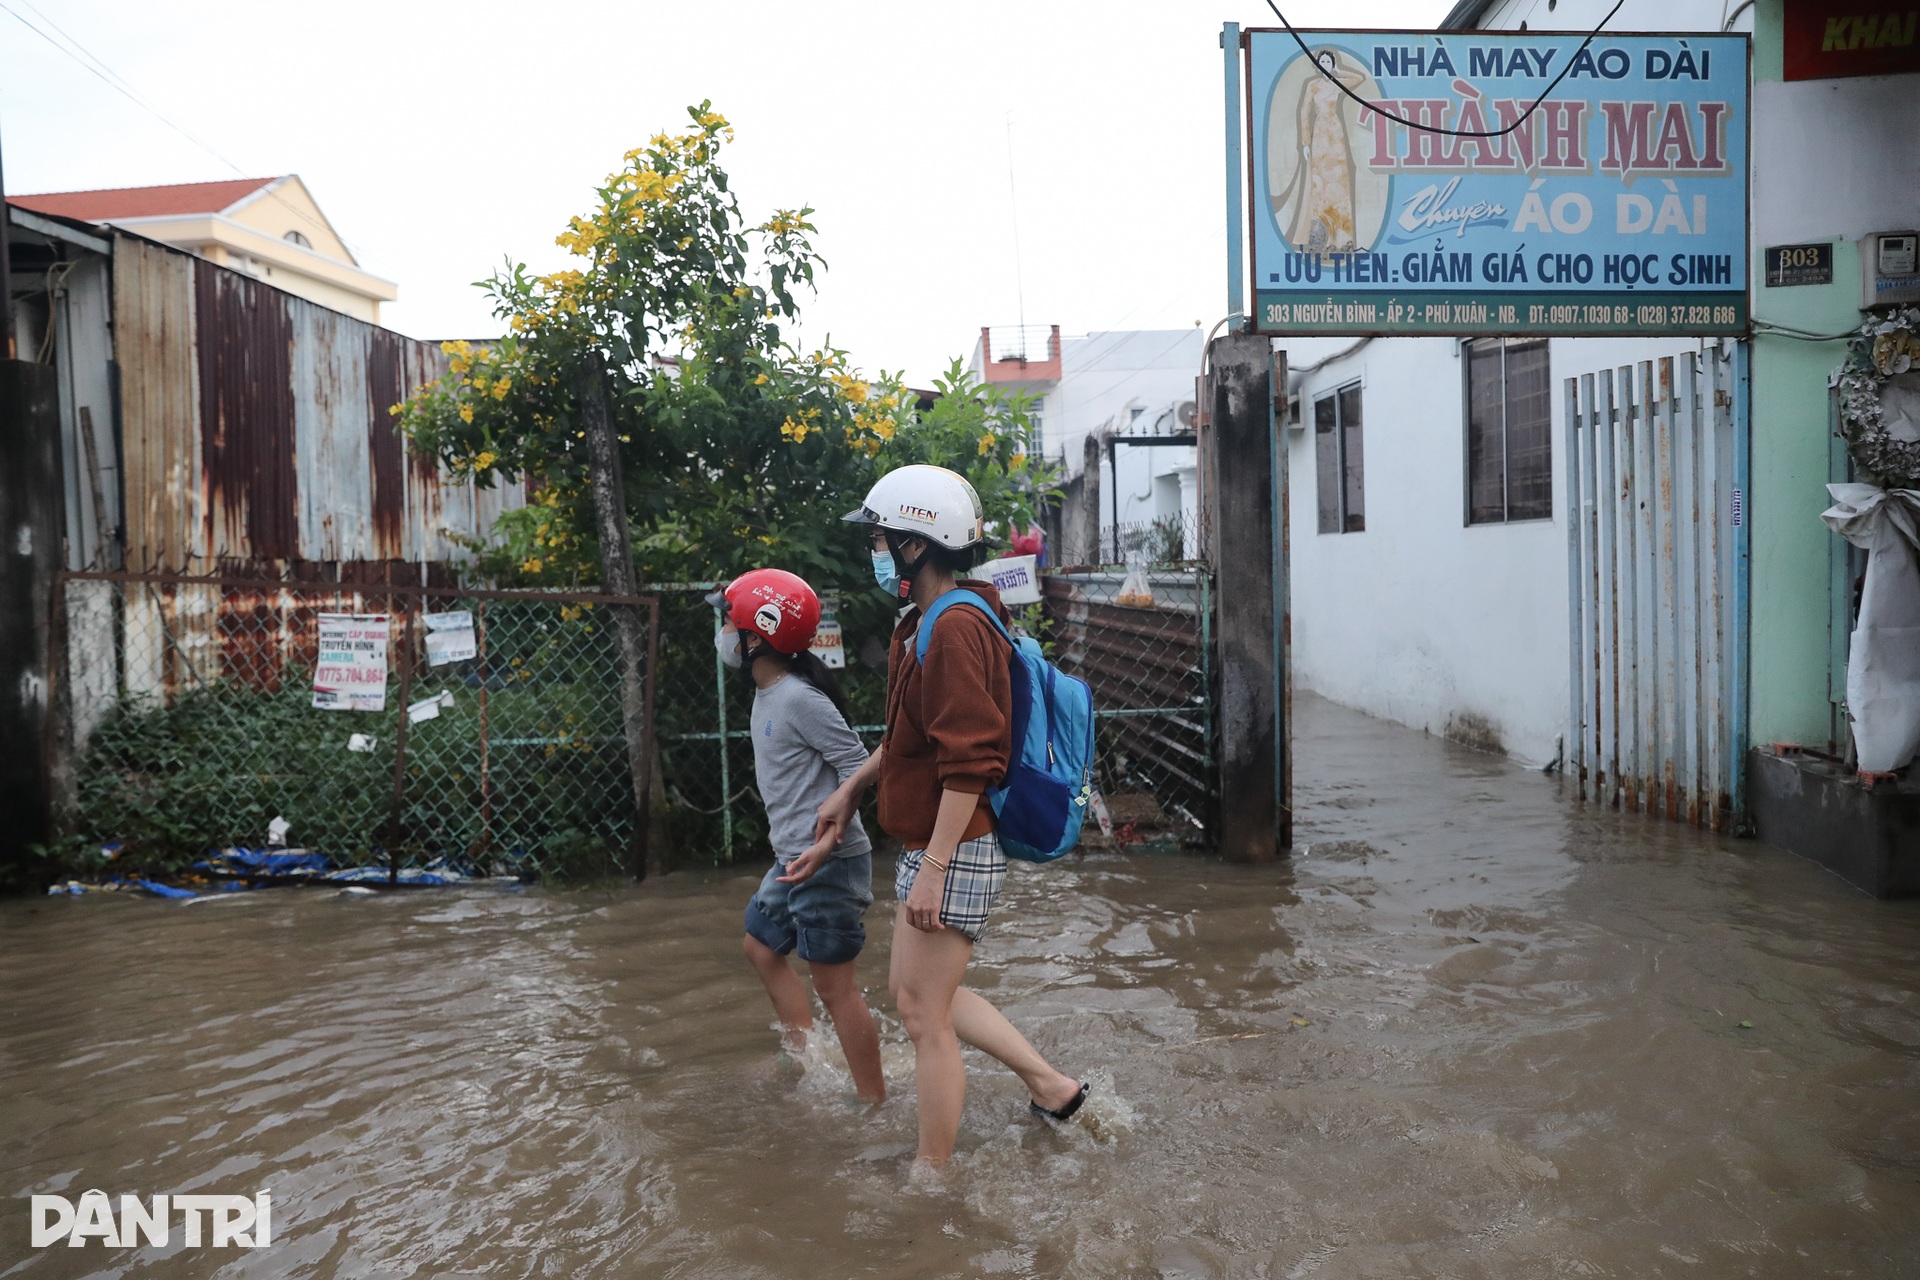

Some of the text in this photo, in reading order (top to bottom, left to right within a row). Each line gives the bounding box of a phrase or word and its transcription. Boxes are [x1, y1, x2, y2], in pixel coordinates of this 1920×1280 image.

[1822, 11, 1918, 52] KHAI
[1373, 38, 1710, 80] NHÀ MAY ÁO DÀI
[1358, 79, 1727, 182] THÀNH MAI
[1398, 176, 1707, 237] Chuyên ÁO DÀI
[1402, 238, 1473, 283] GIẢM
[1482, 242, 1528, 283] GIÁ
[1537, 253, 1594, 285] CHO
[1603, 253, 1659, 289] HỌC
[1668, 254, 1732, 286] SINH
[1779, 248, 1819, 268] 303
[1267, 304, 1290, 324] 303
[1293, 297, 1343, 324] NGUYỄN
[1346, 301, 1376, 324] BÌNH
[1387, 299, 1404, 324] ẤP
[1407, 306, 1415, 324] 2
[1425, 301, 1450, 324] PHÚ
[1453, 302, 1487, 324] XUÂN
[1499, 306, 1520, 324] NB.
[1671, 306, 1711, 324] 37.828
[1713, 306, 1735, 324] 686
[900, 504, 937, 521] UTEN
